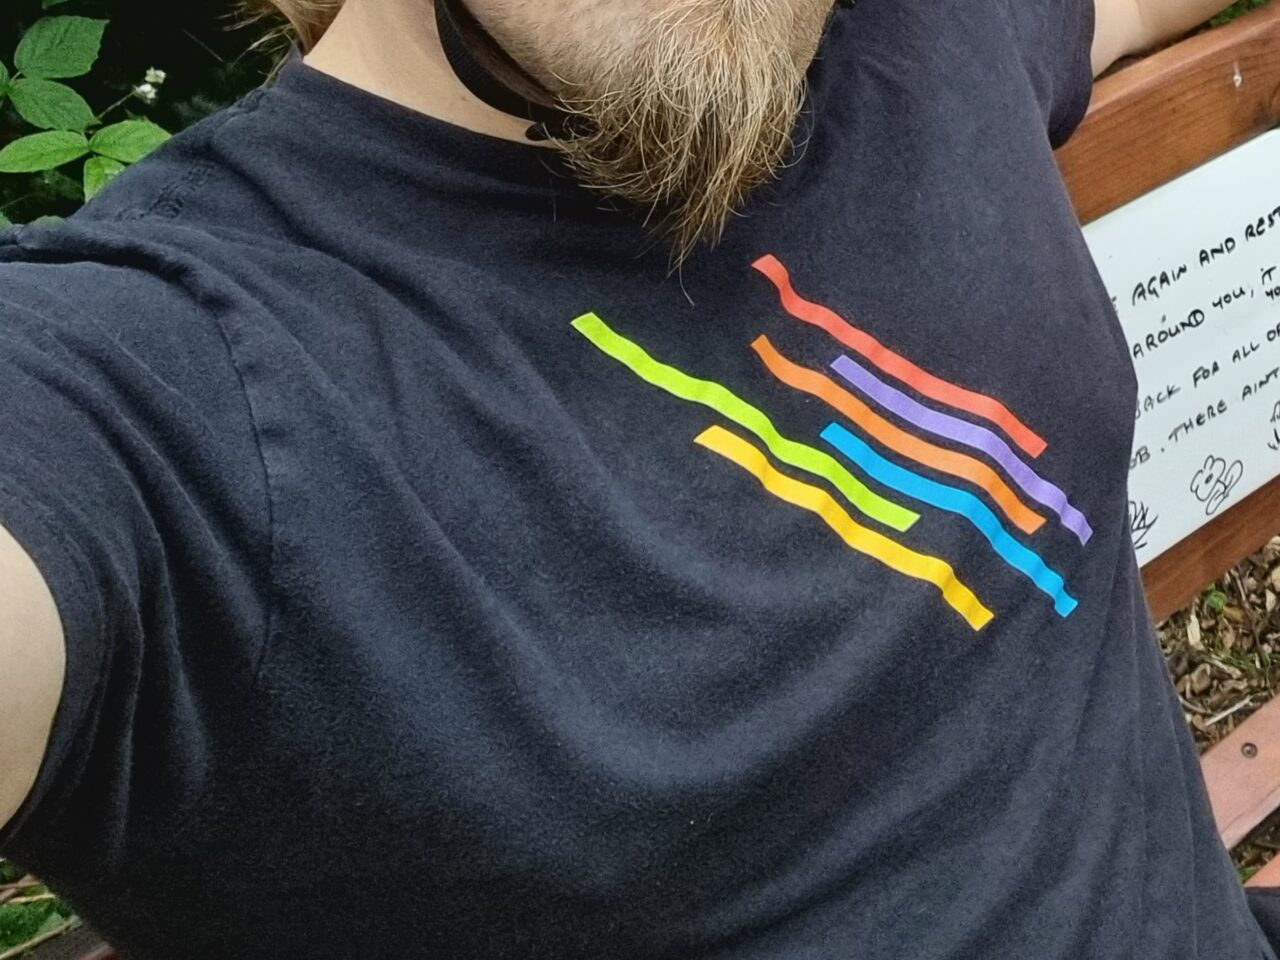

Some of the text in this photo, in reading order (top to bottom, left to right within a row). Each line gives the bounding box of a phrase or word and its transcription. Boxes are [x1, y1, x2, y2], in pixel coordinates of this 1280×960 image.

[1132, 264, 1188, 306] AGAIN
[1199, 236, 1236, 267] AND
[1132, 308, 1205, 359] AROUND
[1260, 265, 1277, 286] IT
[1192, 361, 1220, 388] FOR
[1232, 341, 1260, 364] ALL
[1168, 399, 1228, 443] THERE
[1242, 366, 1280, 401] AINT
